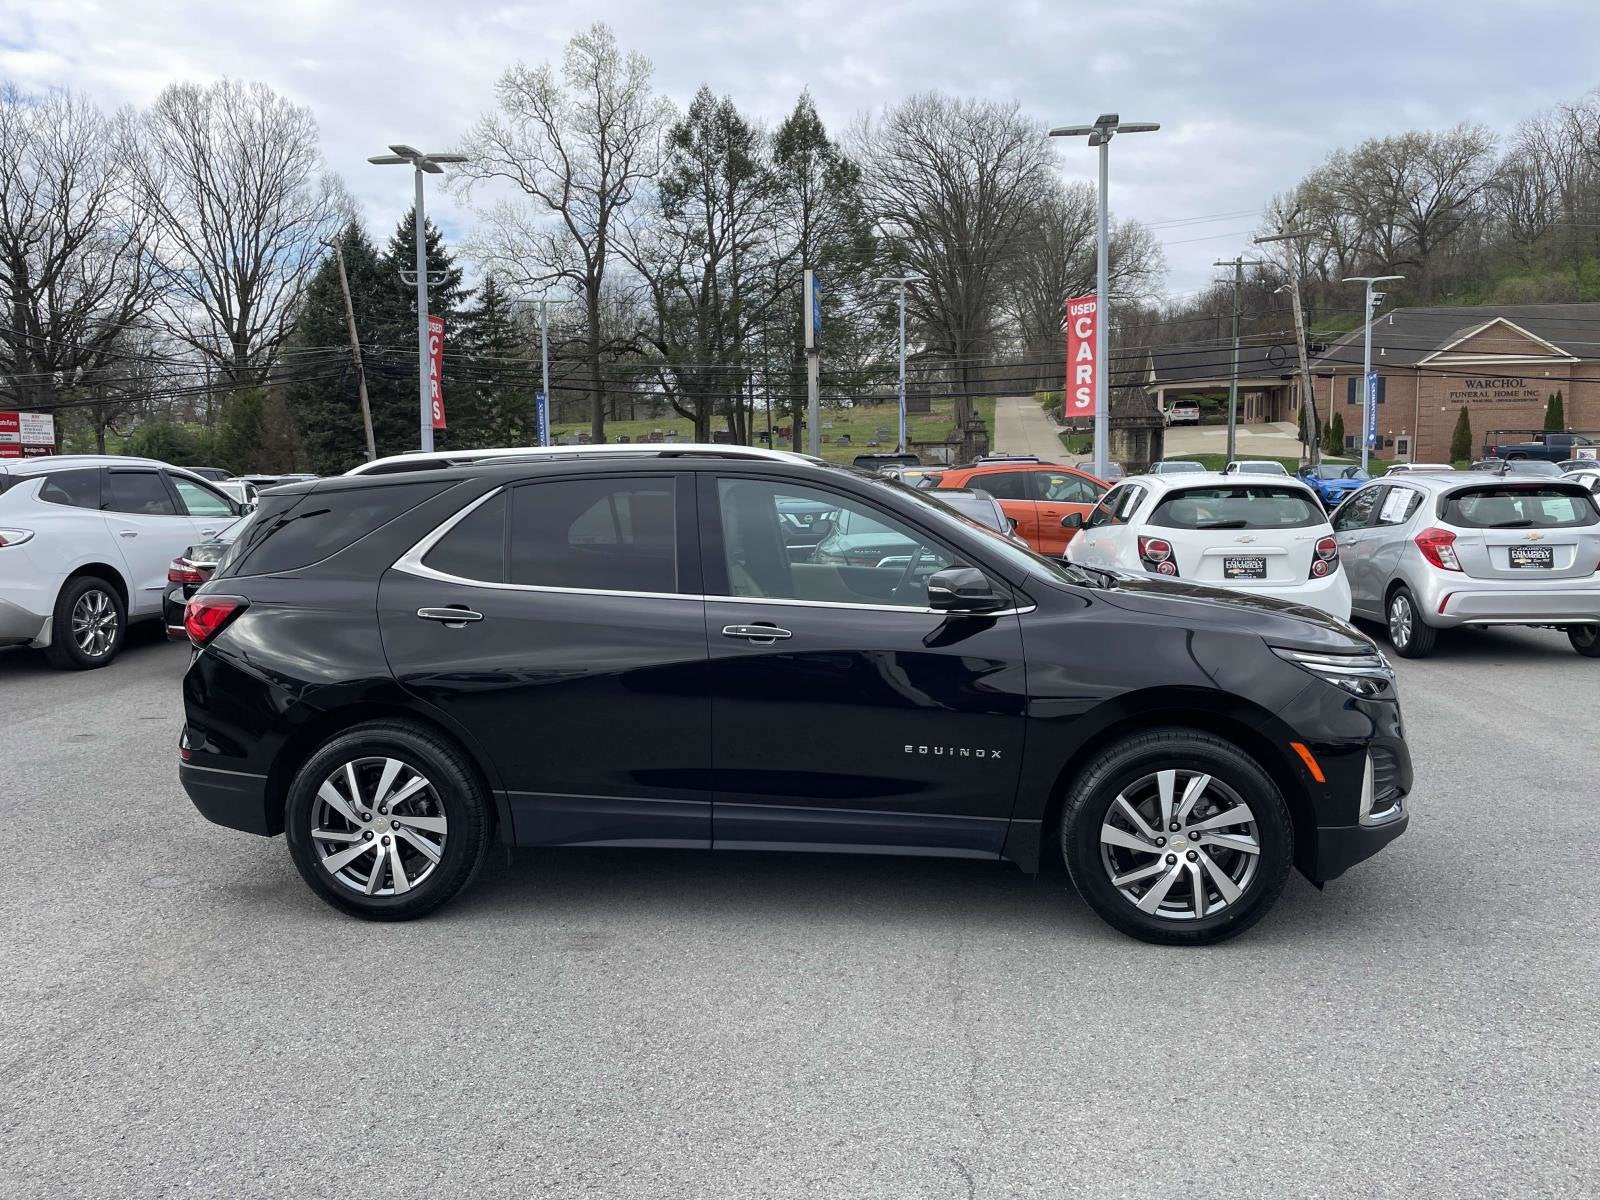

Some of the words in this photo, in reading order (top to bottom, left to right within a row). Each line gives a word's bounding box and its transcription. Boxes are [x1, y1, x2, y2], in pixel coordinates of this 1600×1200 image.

[1070, 303, 1097, 316] USED
[1075, 317, 1093, 408] CARS
[430, 335, 441, 420] CARS
[1465, 378, 1527, 389] WARCHOL
[1450, 391, 1490, 399] FUNERAL
[1494, 390, 1519, 398] HOME
[904, 745, 1001, 759] EQUINOX
